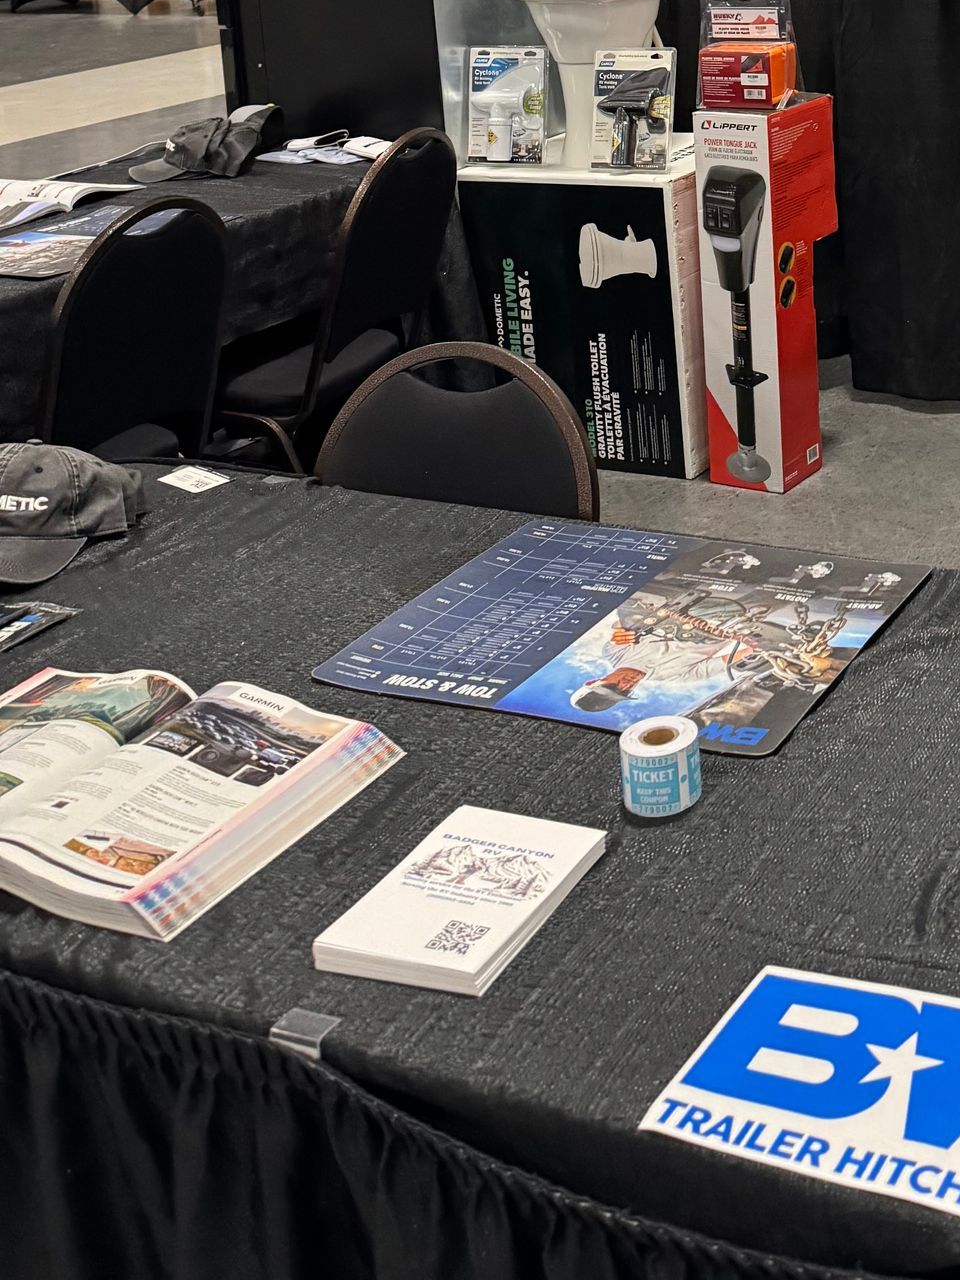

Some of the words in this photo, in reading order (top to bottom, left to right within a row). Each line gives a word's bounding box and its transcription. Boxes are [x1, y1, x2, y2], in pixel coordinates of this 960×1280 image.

[503, 258, 518, 317] LIVING
[518, 270, 532, 320] EASY.
[494, 293, 504, 335] DOMETIC
[508, 320, 522, 356] BILE
[590, 340, 600, 376] TOILET
[598, 333, 611, 401] ÉVACUATION
[585, 399, 593, 417] 310
[593, 372, 602, 408] FLUSH
[611, 392, 623, 437] GRAVITÉ
[595, 409, 606, 459] GRAVITY
[604, 411, 615, 459] TOILETTE
[615, 439, 625, 460] PAR
[382, 674, 439, 689] STOW
[452, 684, 498, 698] TOW
[239, 692, 284, 712] GARMIN
[632, 769, 675, 783] TICKET
[443, 833, 497, 847] BADGER
[498, 844, 554, 859] CANYON
[482, 848, 502, 856] RV
[656, 1098, 829, 1168] TRAILER
